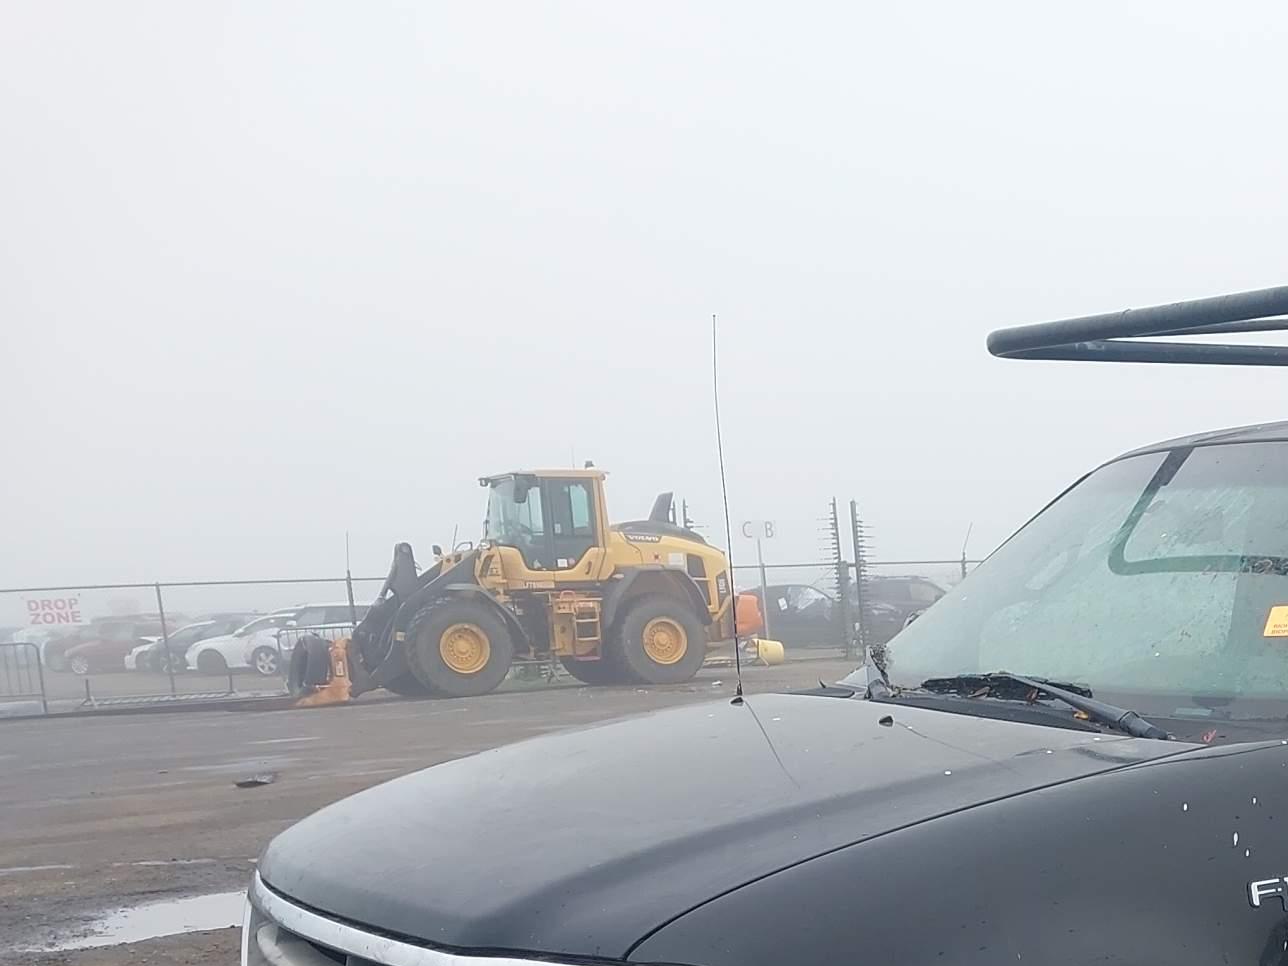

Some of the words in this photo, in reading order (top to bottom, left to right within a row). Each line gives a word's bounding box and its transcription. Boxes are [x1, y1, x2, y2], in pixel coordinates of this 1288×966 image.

[764, 520, 774, 539] B
[27, 598, 78, 612] DROP
[30, 610, 81, 625] ZONE
